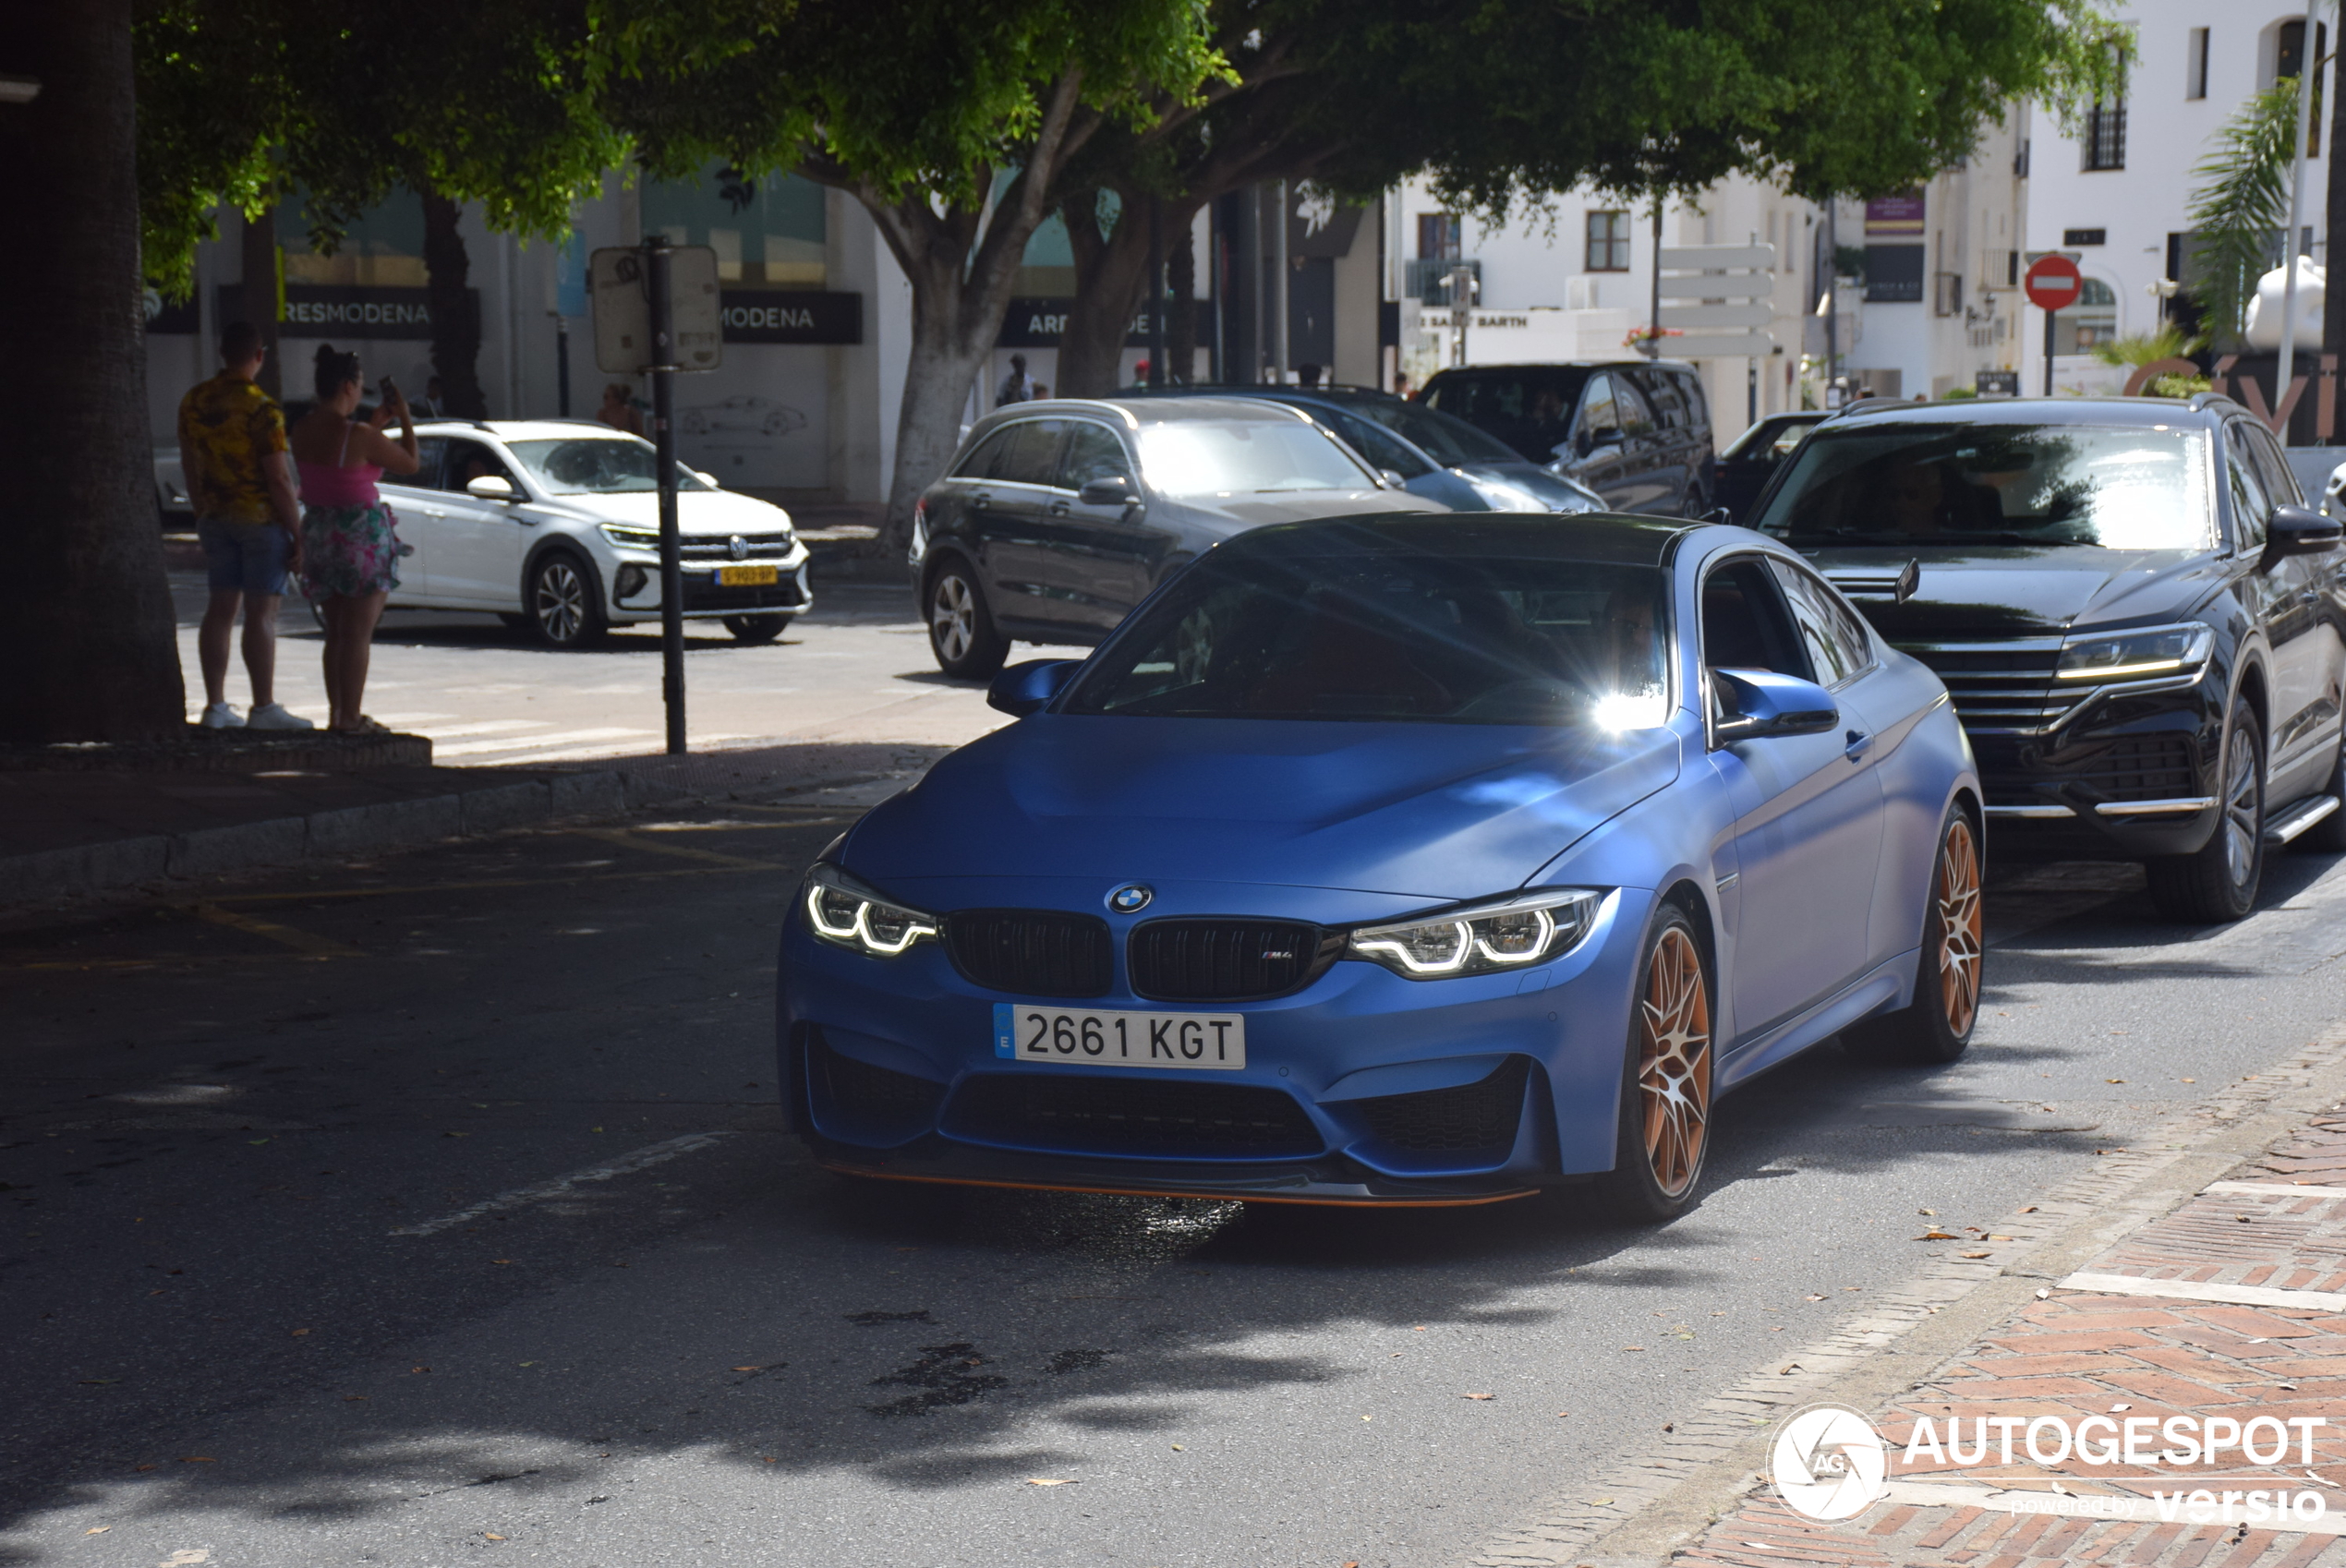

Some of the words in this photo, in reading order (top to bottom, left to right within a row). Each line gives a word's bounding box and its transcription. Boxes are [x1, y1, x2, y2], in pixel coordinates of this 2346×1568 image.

[1477, 315, 1528, 327] BARTH
[1000, 1036, 1010, 1048] E
[1026, 1013, 1128, 1057] 2661
[1150, 1019, 1233, 1060] KGT
